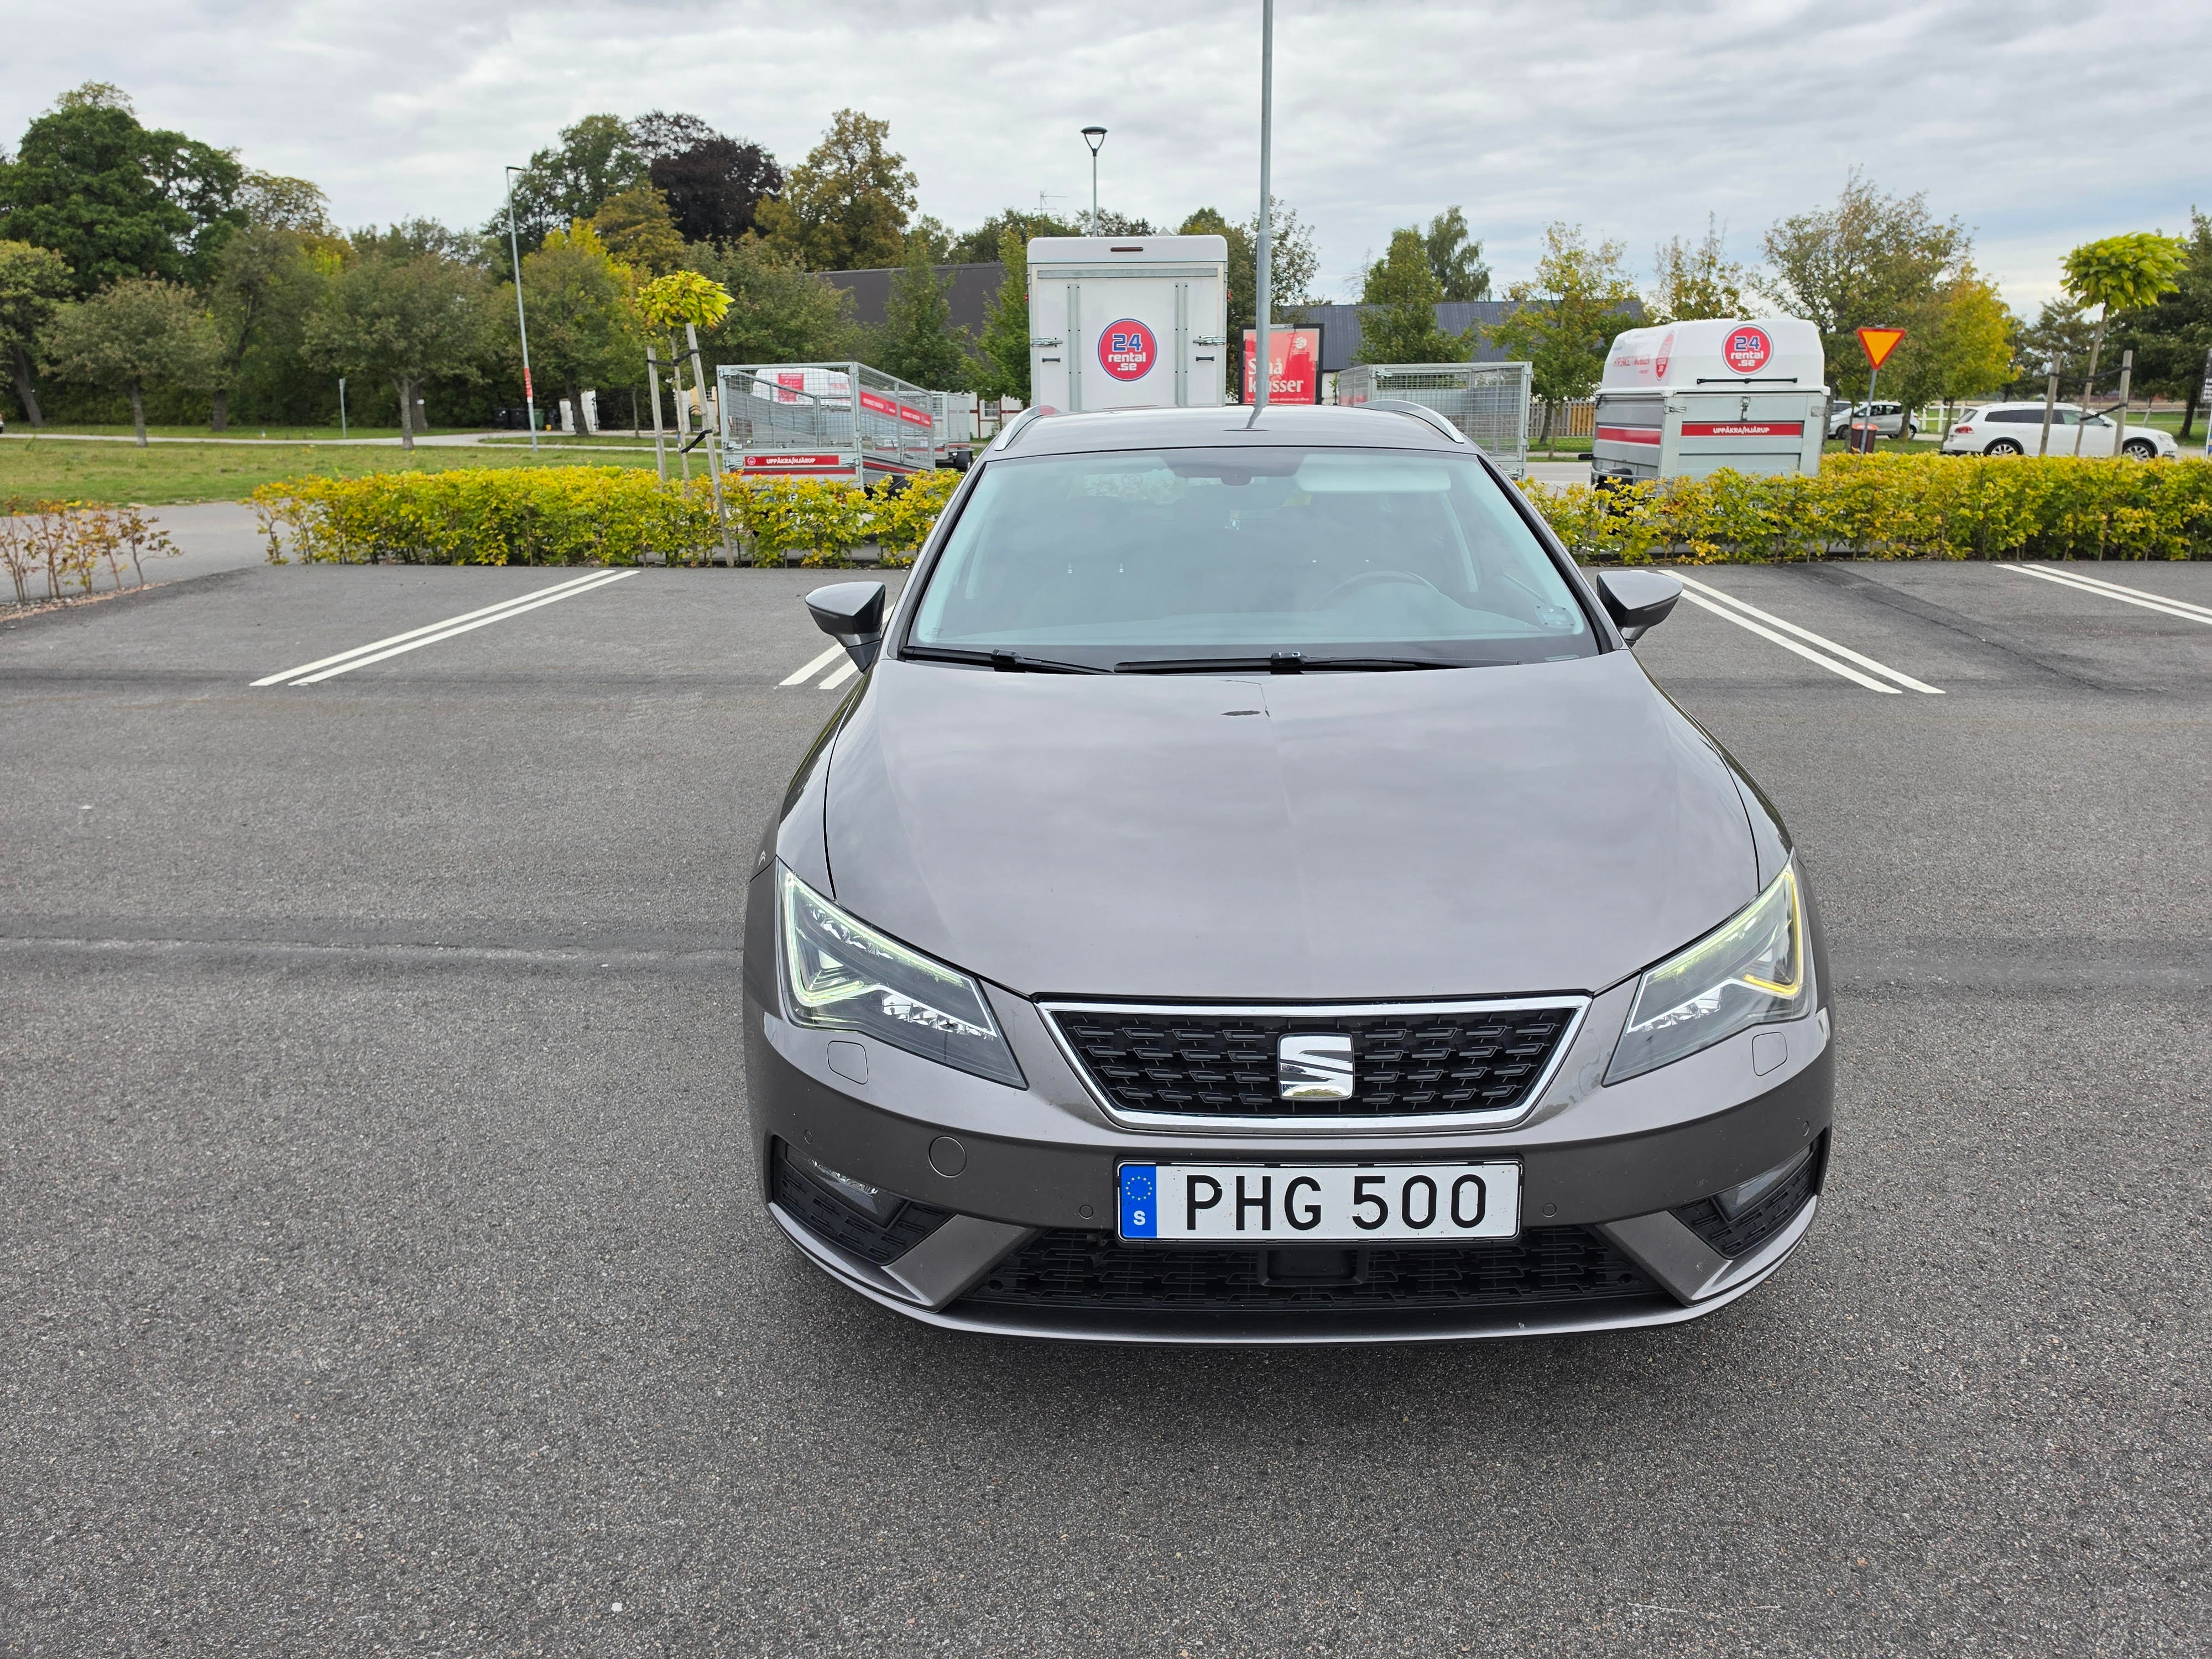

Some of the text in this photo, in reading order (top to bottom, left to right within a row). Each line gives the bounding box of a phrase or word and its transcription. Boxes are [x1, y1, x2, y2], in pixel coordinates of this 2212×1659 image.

[1112, 333, 1142, 352] 24
[1734, 336, 1761, 351] 24
[1108, 352, 1146, 362] rental
[1730, 351, 1764, 359] rental
[1117, 363, 1138, 371] .se
[1186, 1175, 1487, 1231] PHG 500
[1133, 1210, 1146, 1225] S
